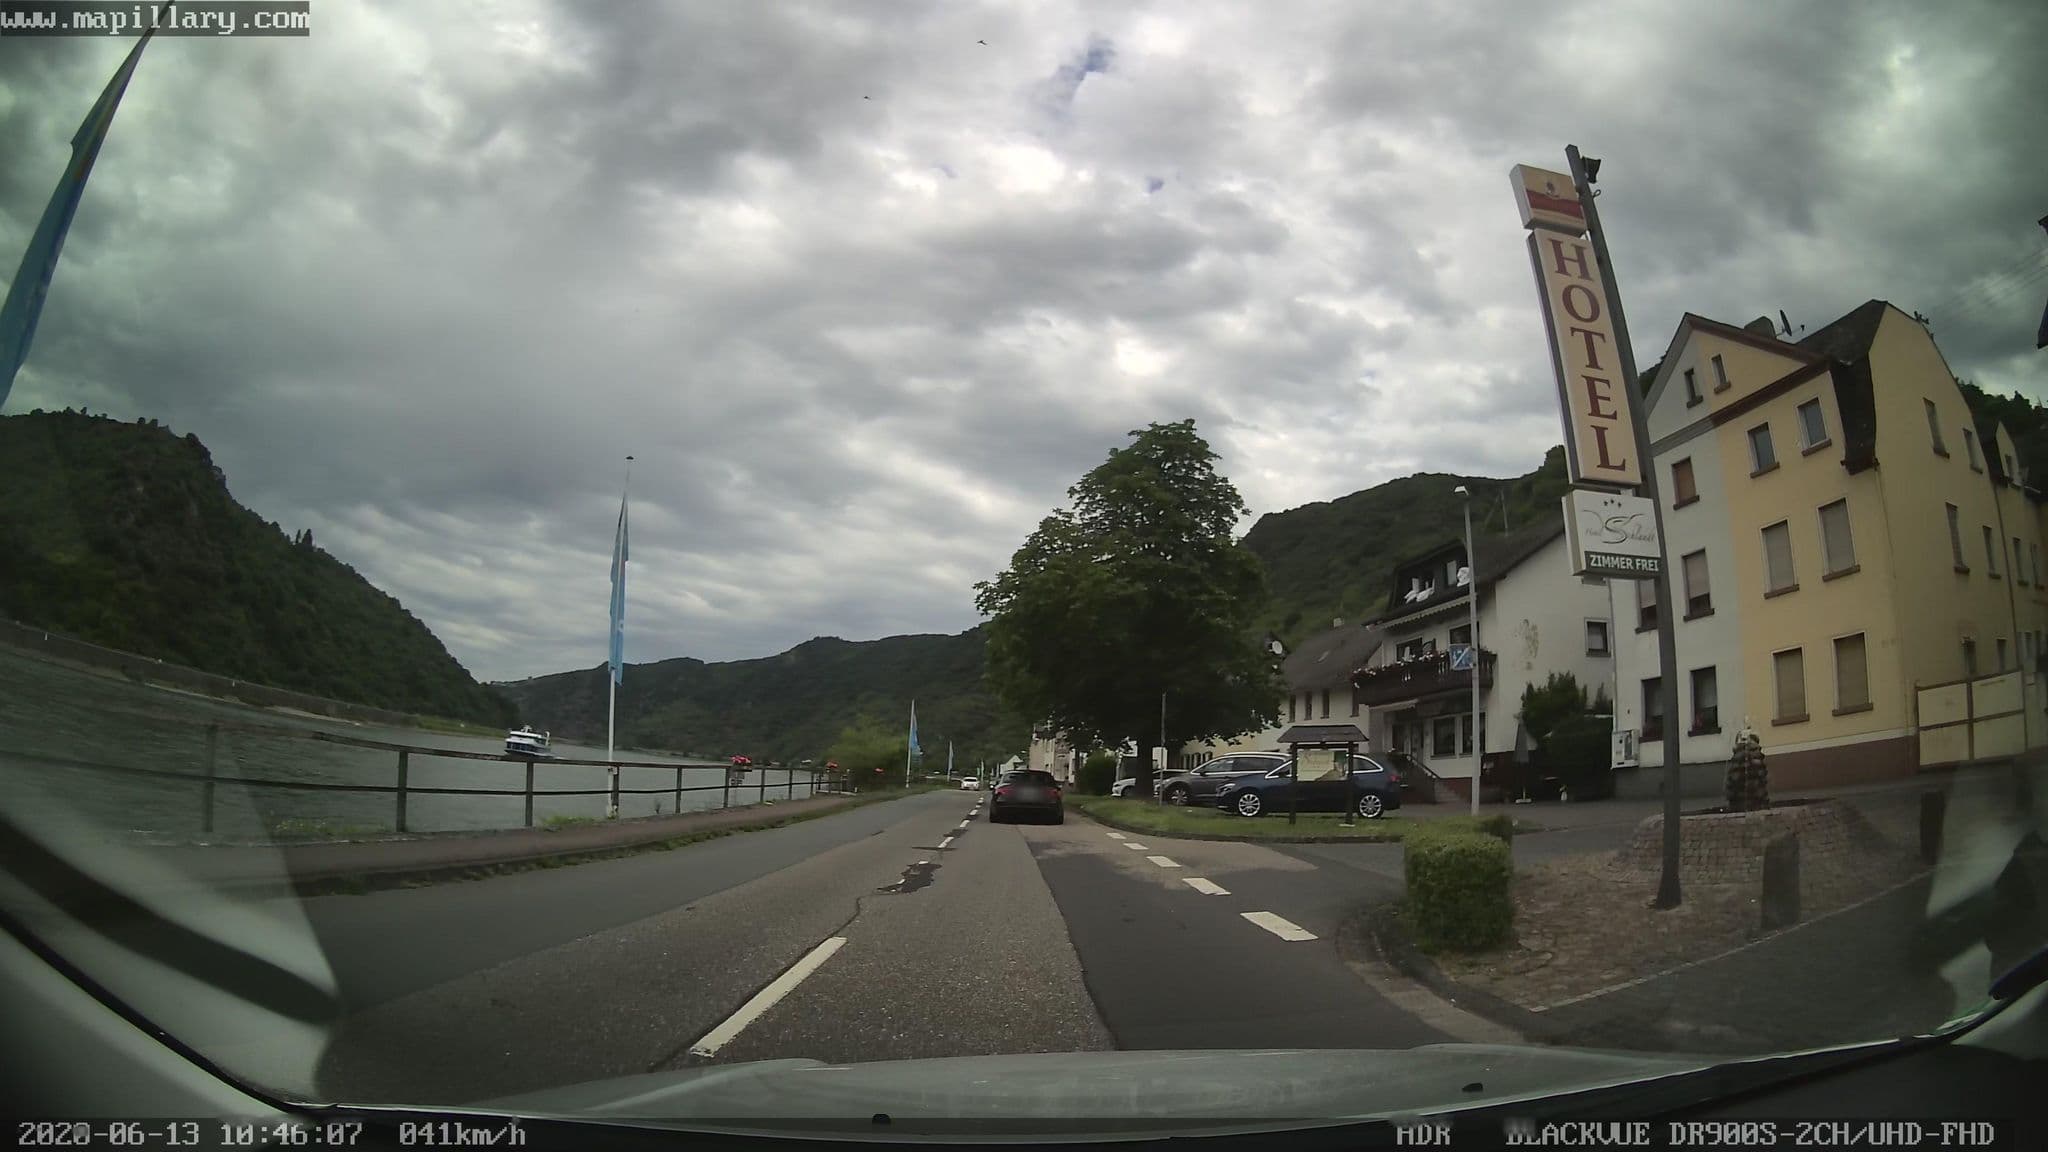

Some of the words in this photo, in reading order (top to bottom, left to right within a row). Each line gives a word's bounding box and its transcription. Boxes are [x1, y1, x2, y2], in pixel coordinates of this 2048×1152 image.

[1547, 237, 1626, 472] HOTEL
[1590, 554, 1634, 570] ZIMMER
[1635, 558, 1659, 572] FREI
